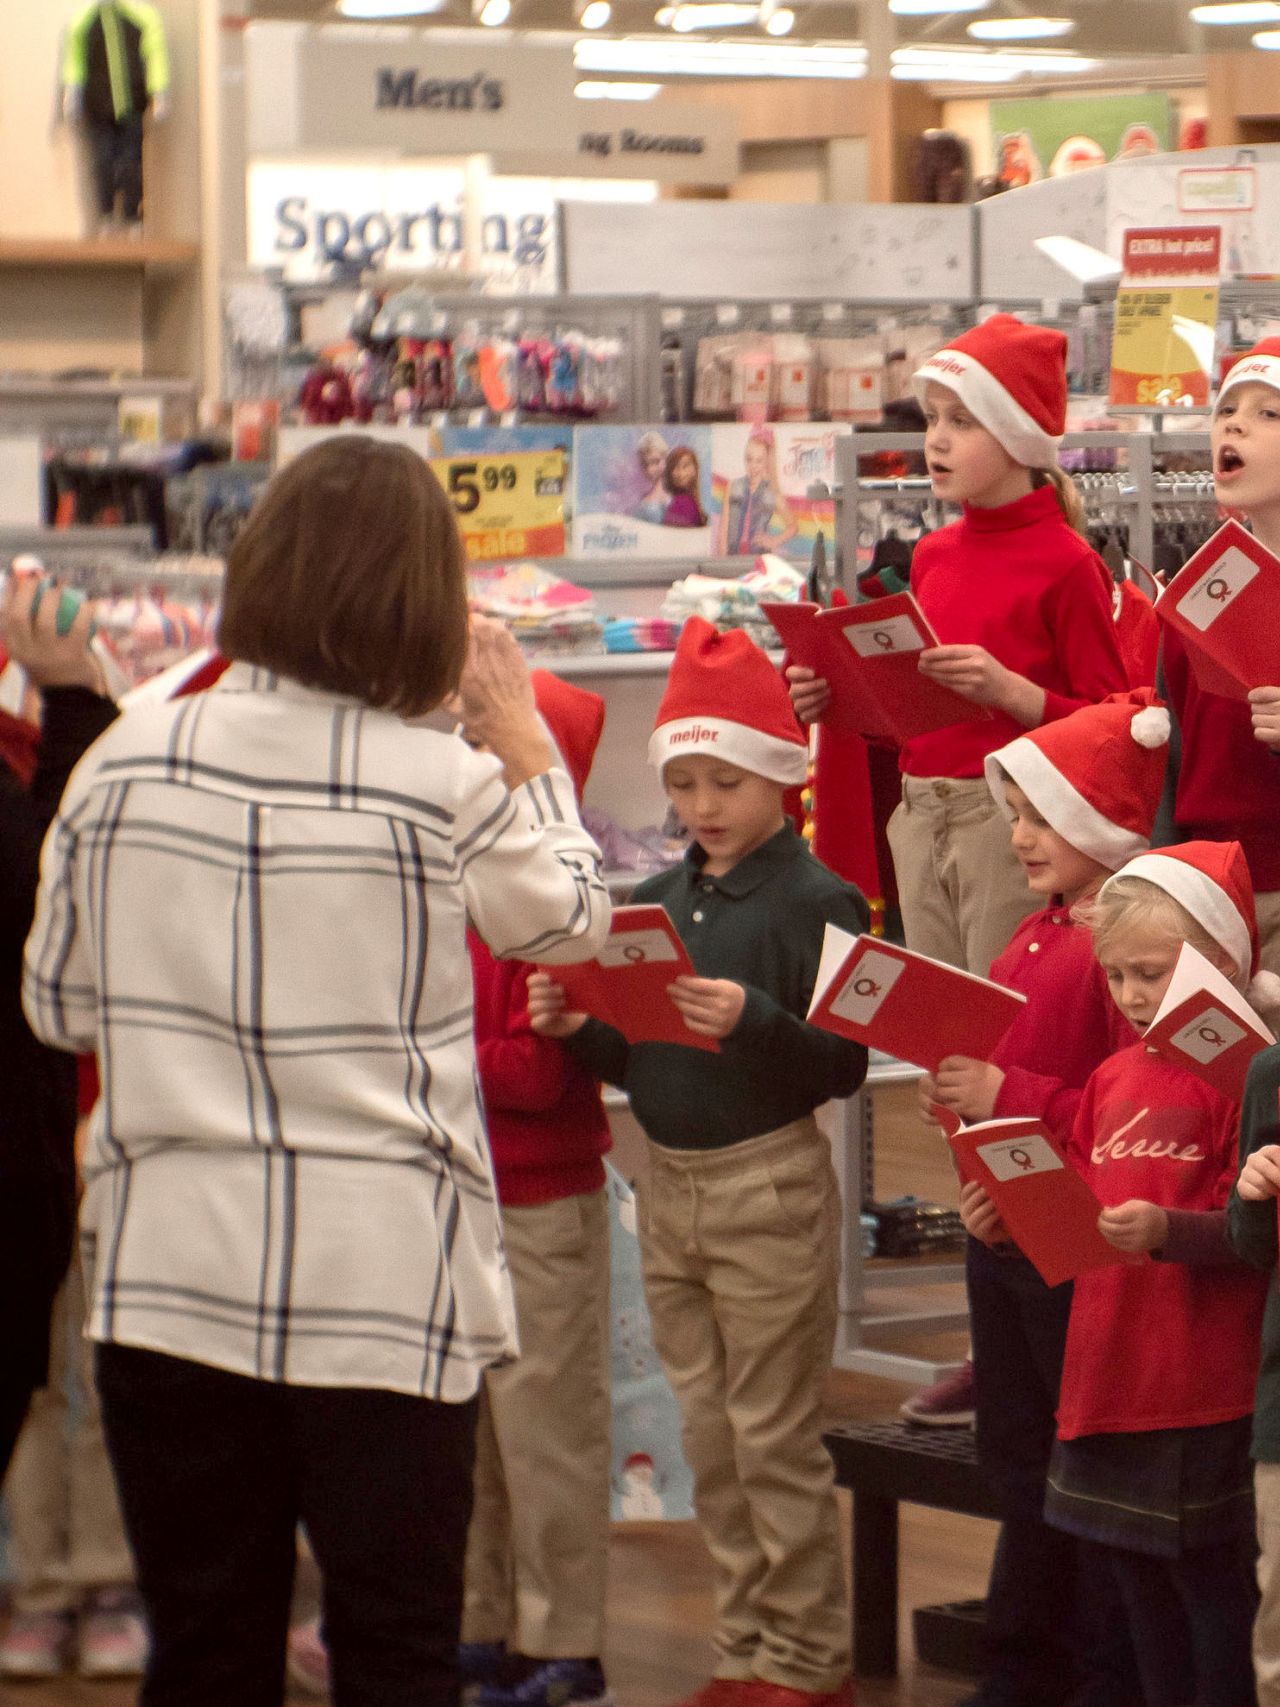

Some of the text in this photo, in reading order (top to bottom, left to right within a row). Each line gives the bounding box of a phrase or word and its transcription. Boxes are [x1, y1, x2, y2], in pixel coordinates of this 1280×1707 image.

[375, 67, 504, 111] Men's
[621, 129, 704, 154] Rooms
[275, 195, 546, 267] Sporting
[669, 725, 719, 744] meijer
